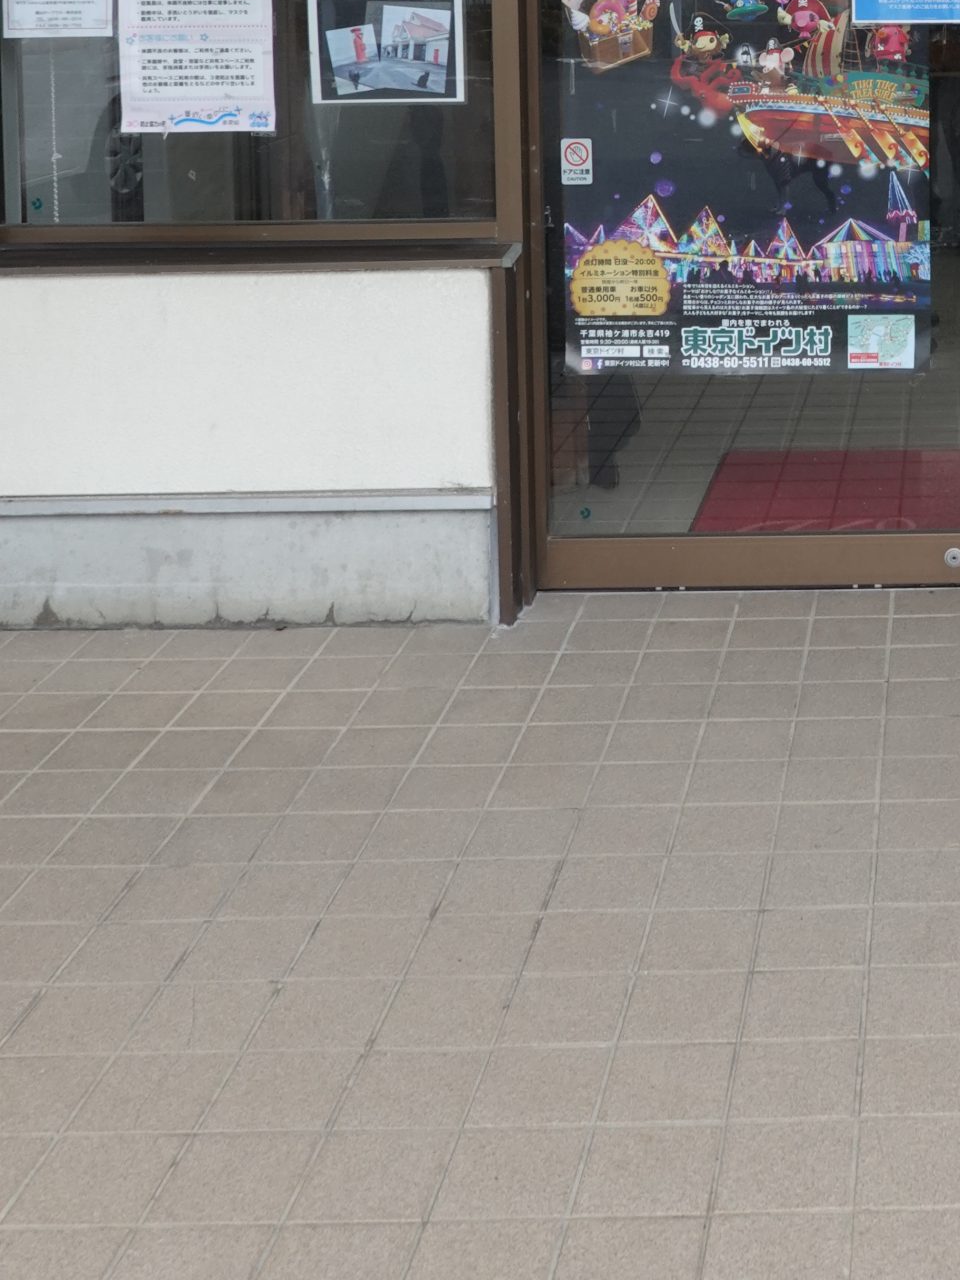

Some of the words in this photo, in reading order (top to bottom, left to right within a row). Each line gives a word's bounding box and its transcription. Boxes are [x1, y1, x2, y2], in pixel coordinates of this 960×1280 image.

[583, 258, 612, 266] 点灯時間
[579, 269, 659, 277] イルミネーション特別料金
[630, 285, 658, 293] お車以外
[681, 326, 833, 356] 東京ドイツ村
[690, 356, 769, 368] 0438-60-5511
[781, 357, 831, 367] 0438-60-5512
